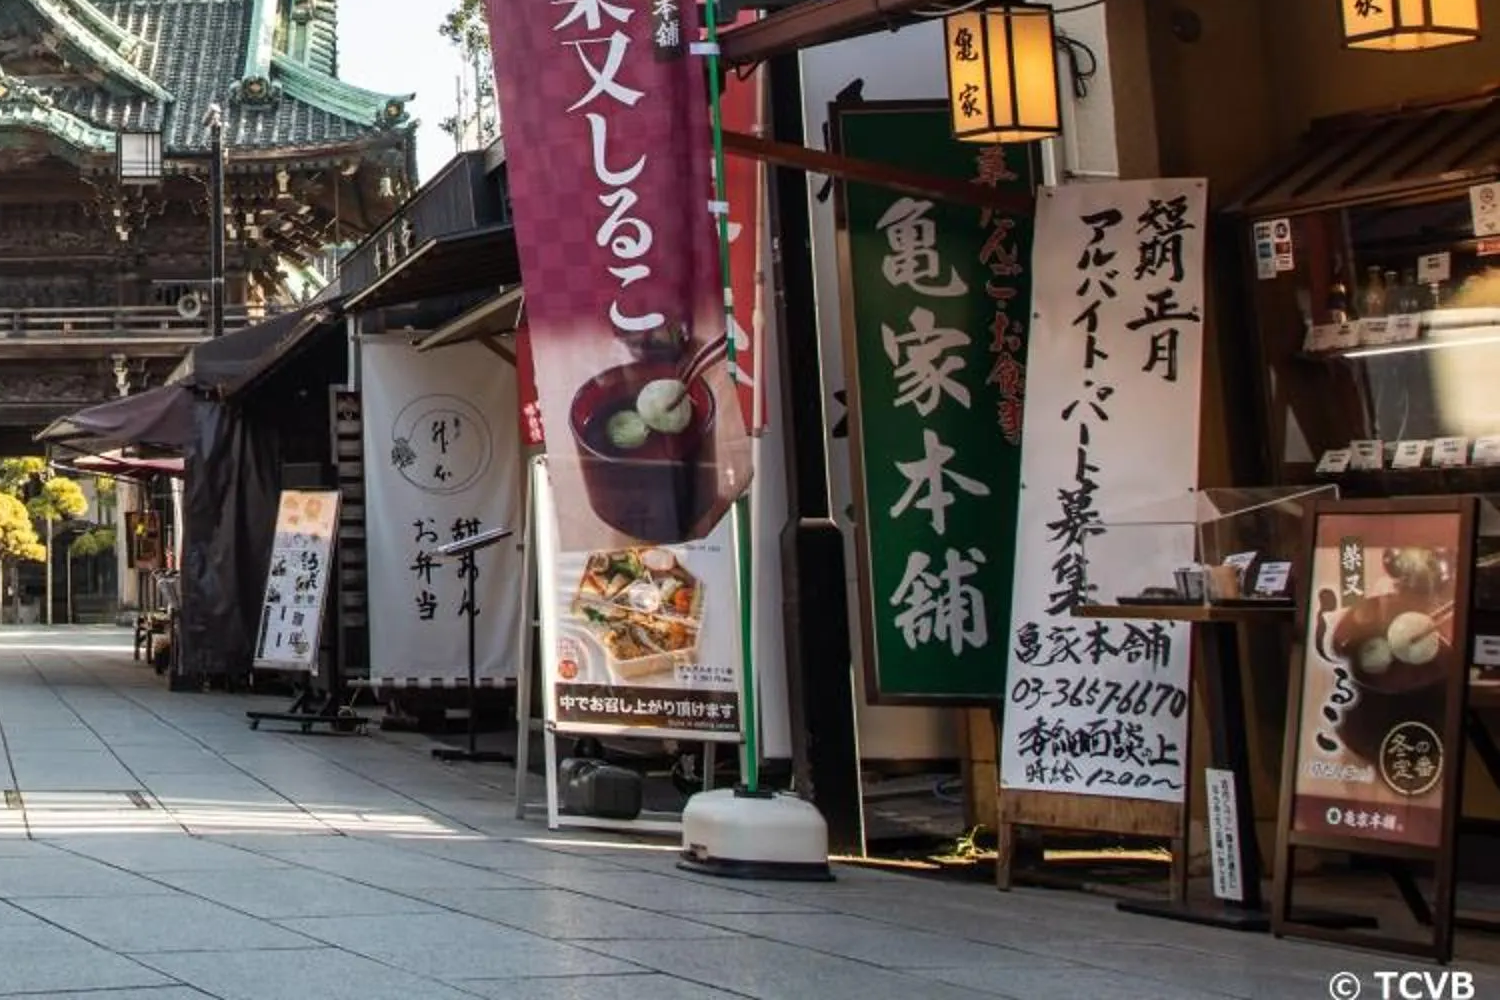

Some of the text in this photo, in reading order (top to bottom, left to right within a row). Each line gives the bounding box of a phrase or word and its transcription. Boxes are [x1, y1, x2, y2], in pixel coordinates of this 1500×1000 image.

[954, 27, 982, 118] 亀家
[1126, 195, 1200, 383] 短期正月
[875, 196, 990, 657] 亀家本舗
[411, 518, 441, 621] お弁当
[1341, 544, 1364, 598] 柴又
[1015, 620, 1175, 673] 亀家本舗
[1314, 587, 1355, 753] しるこ
[559, 695, 735, 719] 中でお召し上がり頂けます
[1025, 759, 1084, 784] 時給
[1388, 733, 1430, 757] 冬の
